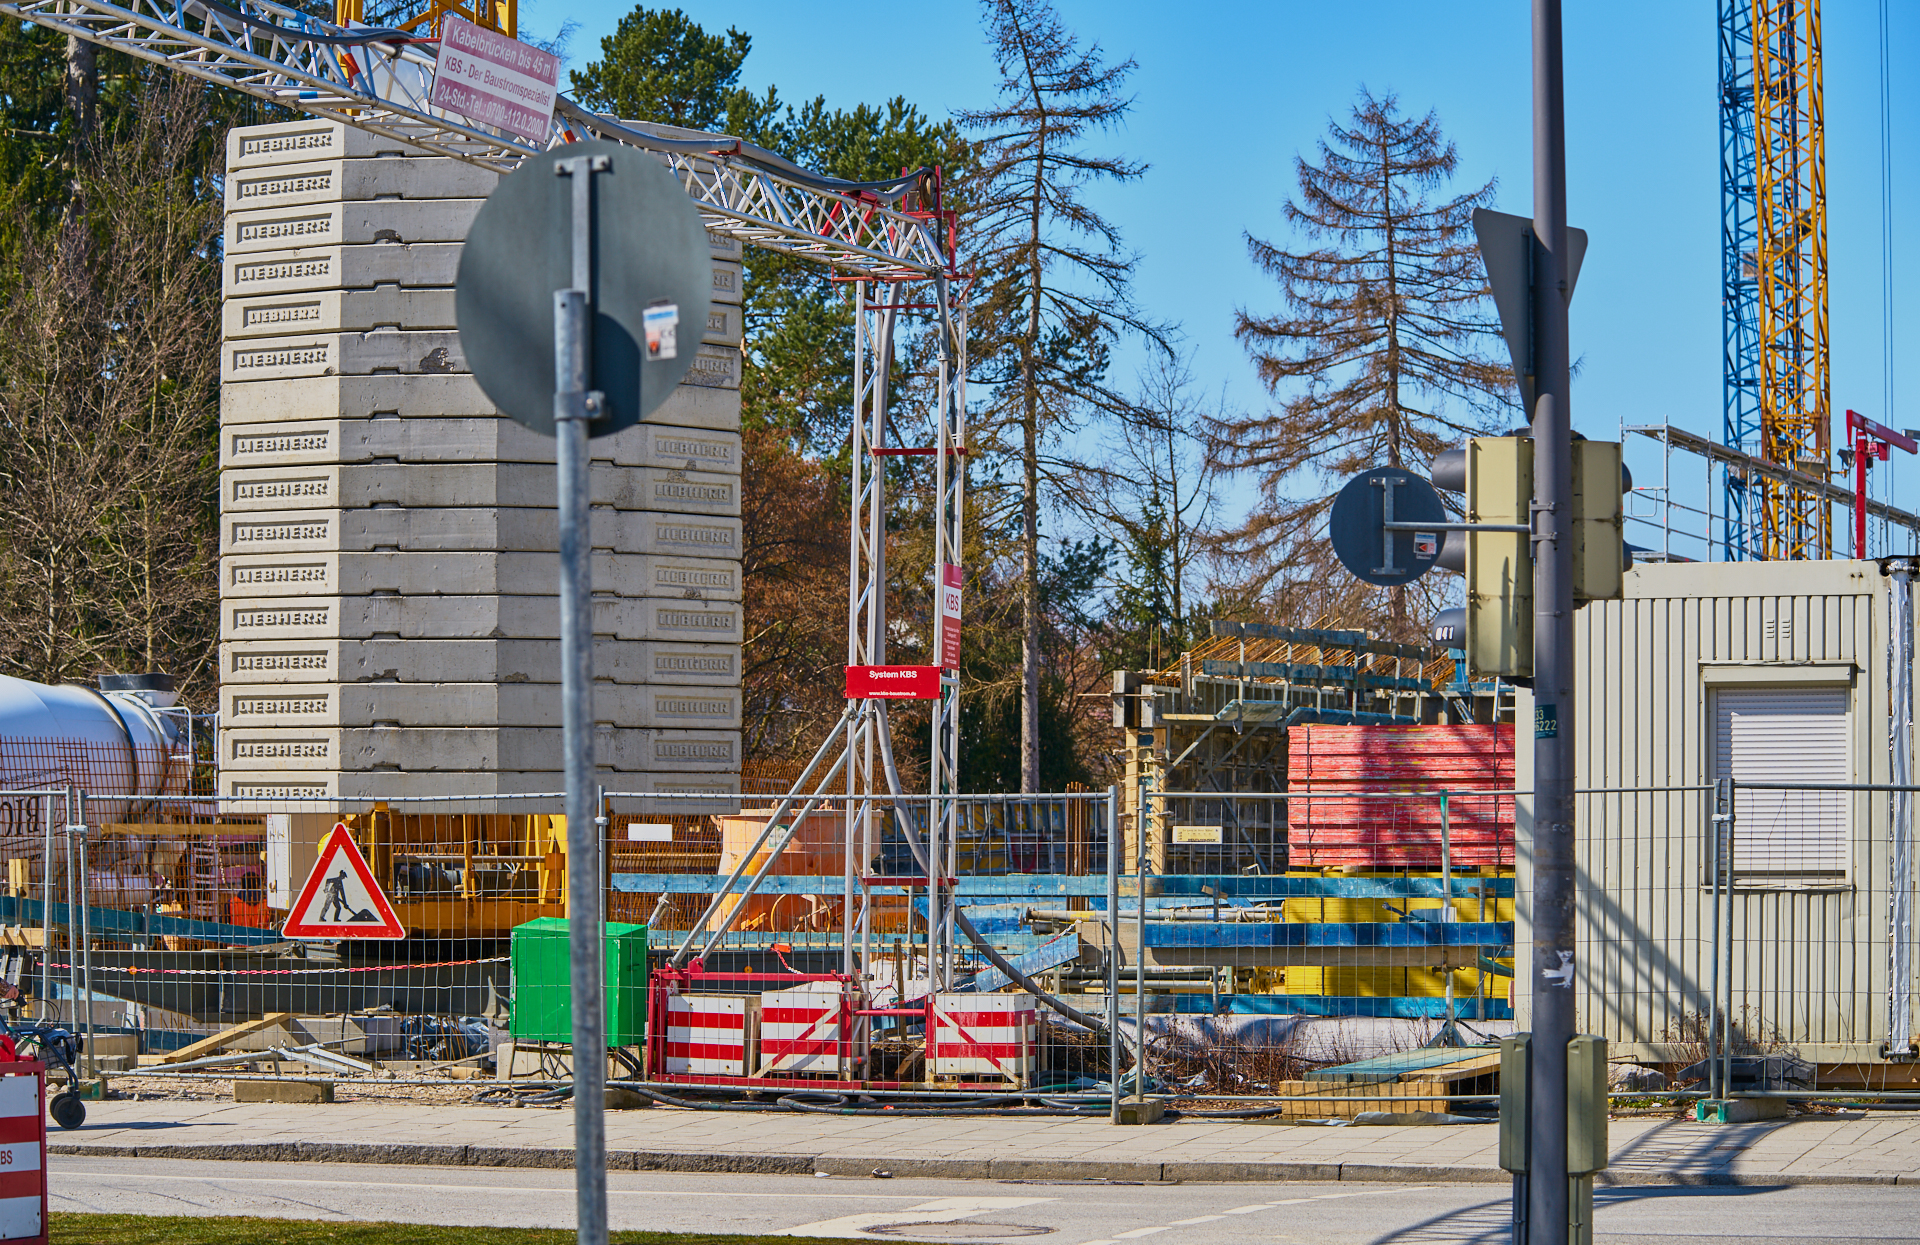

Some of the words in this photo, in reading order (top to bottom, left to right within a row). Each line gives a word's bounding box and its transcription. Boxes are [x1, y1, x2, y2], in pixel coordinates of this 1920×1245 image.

[452, 25, 516, 63] Kabelbrücken
[518, 49, 531, 69] bis
[532, 55, 543, 73] 45
[543, 64, 551, 76] m
[445, 55, 463, 74] KBS
[468, 64, 483, 80] Der
[484, 70, 551, 107] Baustromspezialist
[245, 133, 332, 154] LIEBHERR
[243, 177, 331, 197] LIEBHERR
[242, 220, 330, 240] LIEBHERR
[241, 263, 329, 282] LIEBHERR
[249, 308, 319, 324] LIEBHERR
[239, 351, 327, 368] LIEBHERR
[691, 358, 730, 374] HERR
[238, 437, 328, 453] LIEBHERR
[657, 440, 730, 458] LIEBHERR
[239, 483, 328, 498] LIEBHERR
[655, 484, 728, 501] LIEBHERR
[238, 526, 327, 541] LIEBHERR
[657, 527, 730, 544] LIEBHERR
[237, 569, 326, 584] LIEBHERR
[657, 570, 729, 586] LIEBHERR
[945, 593, 959, 612] KBS
[239, 611, 328, 627] LIEBHERR
[658, 613, 731, 628] LIEBHERR
[239, 655, 328, 671] LIEBHERR
[656, 657, 729, 671] LIEBHERR
[869, 670, 899, 680] System
[899, 670, 917, 679] KBS
[239, 699, 328, 715] LIEBHERR
[656, 700, 728, 714] LIEBHERR
[239, 743, 328, 758] LIEBHERR
[656, 743, 729, 758] LIEBHERR
[0, 1149, 13, 1165] BS
